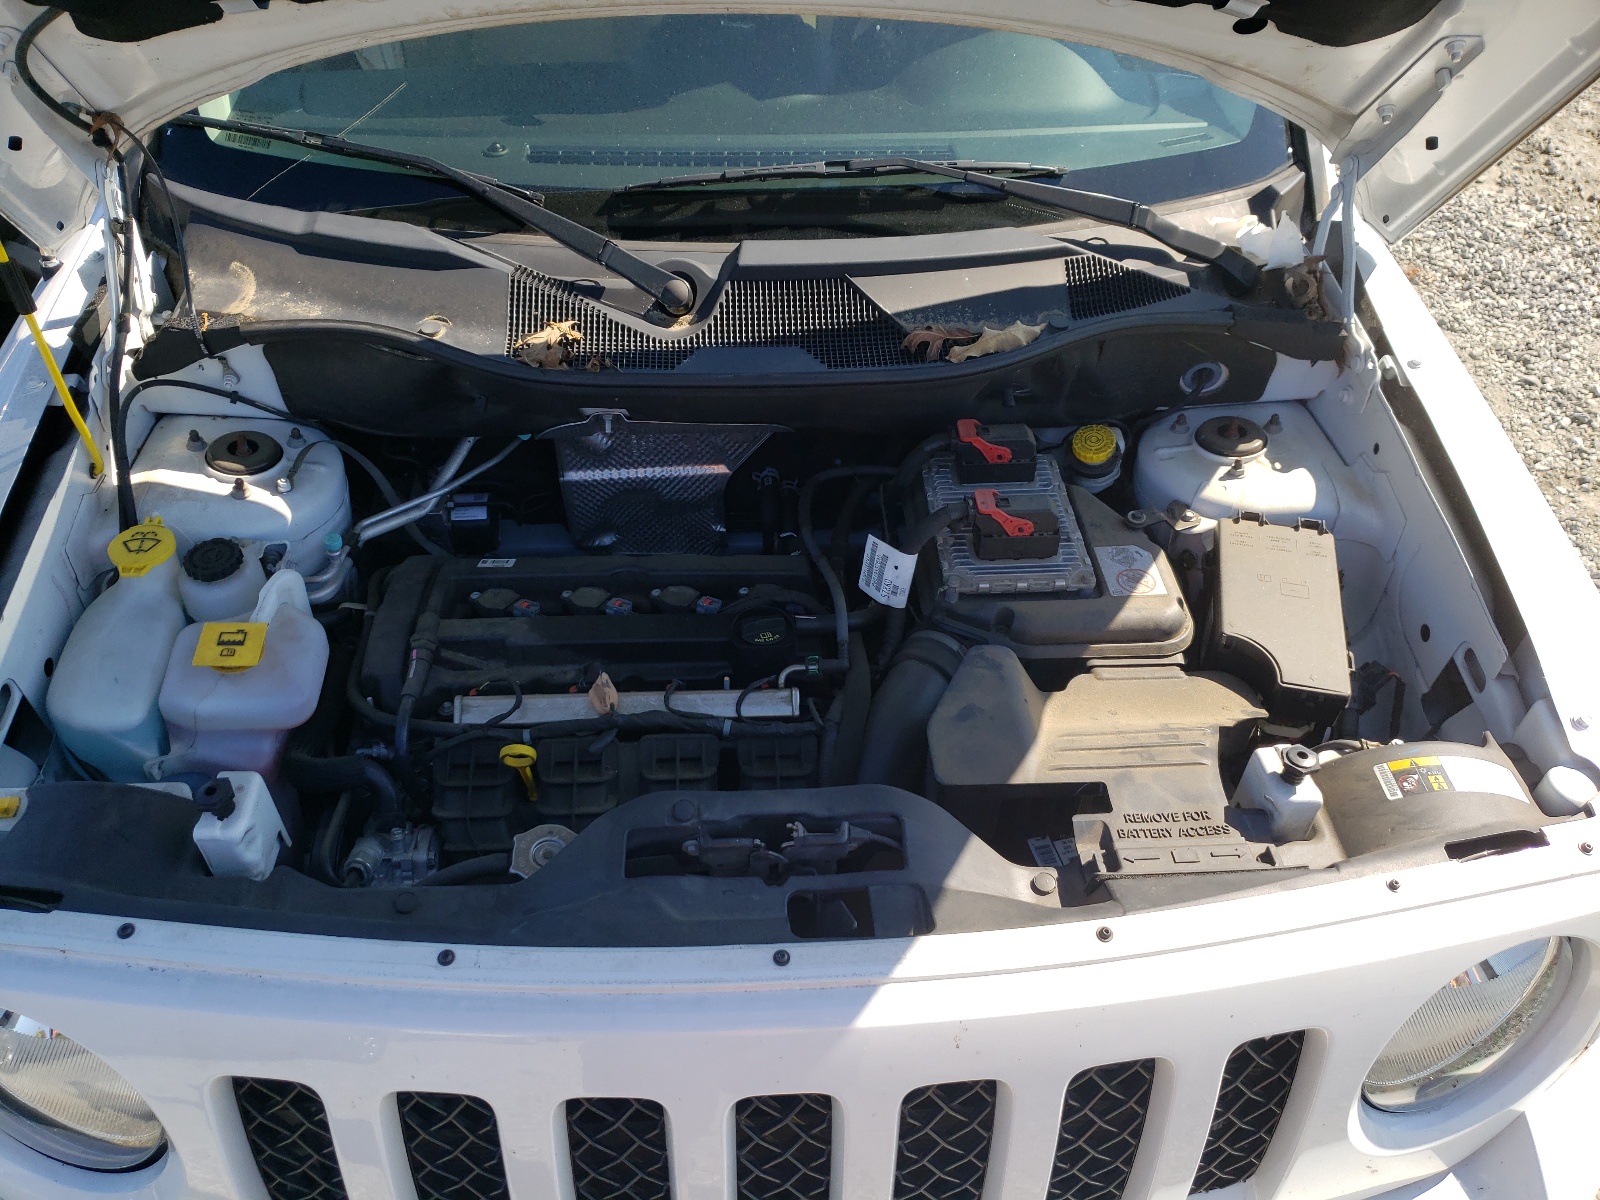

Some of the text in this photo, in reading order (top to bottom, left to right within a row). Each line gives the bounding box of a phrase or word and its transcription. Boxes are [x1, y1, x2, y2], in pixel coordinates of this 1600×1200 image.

[1123, 810, 1212, 824] REMOVE FOR
[1116, 824, 1231, 839] BATTERY ACCESS
